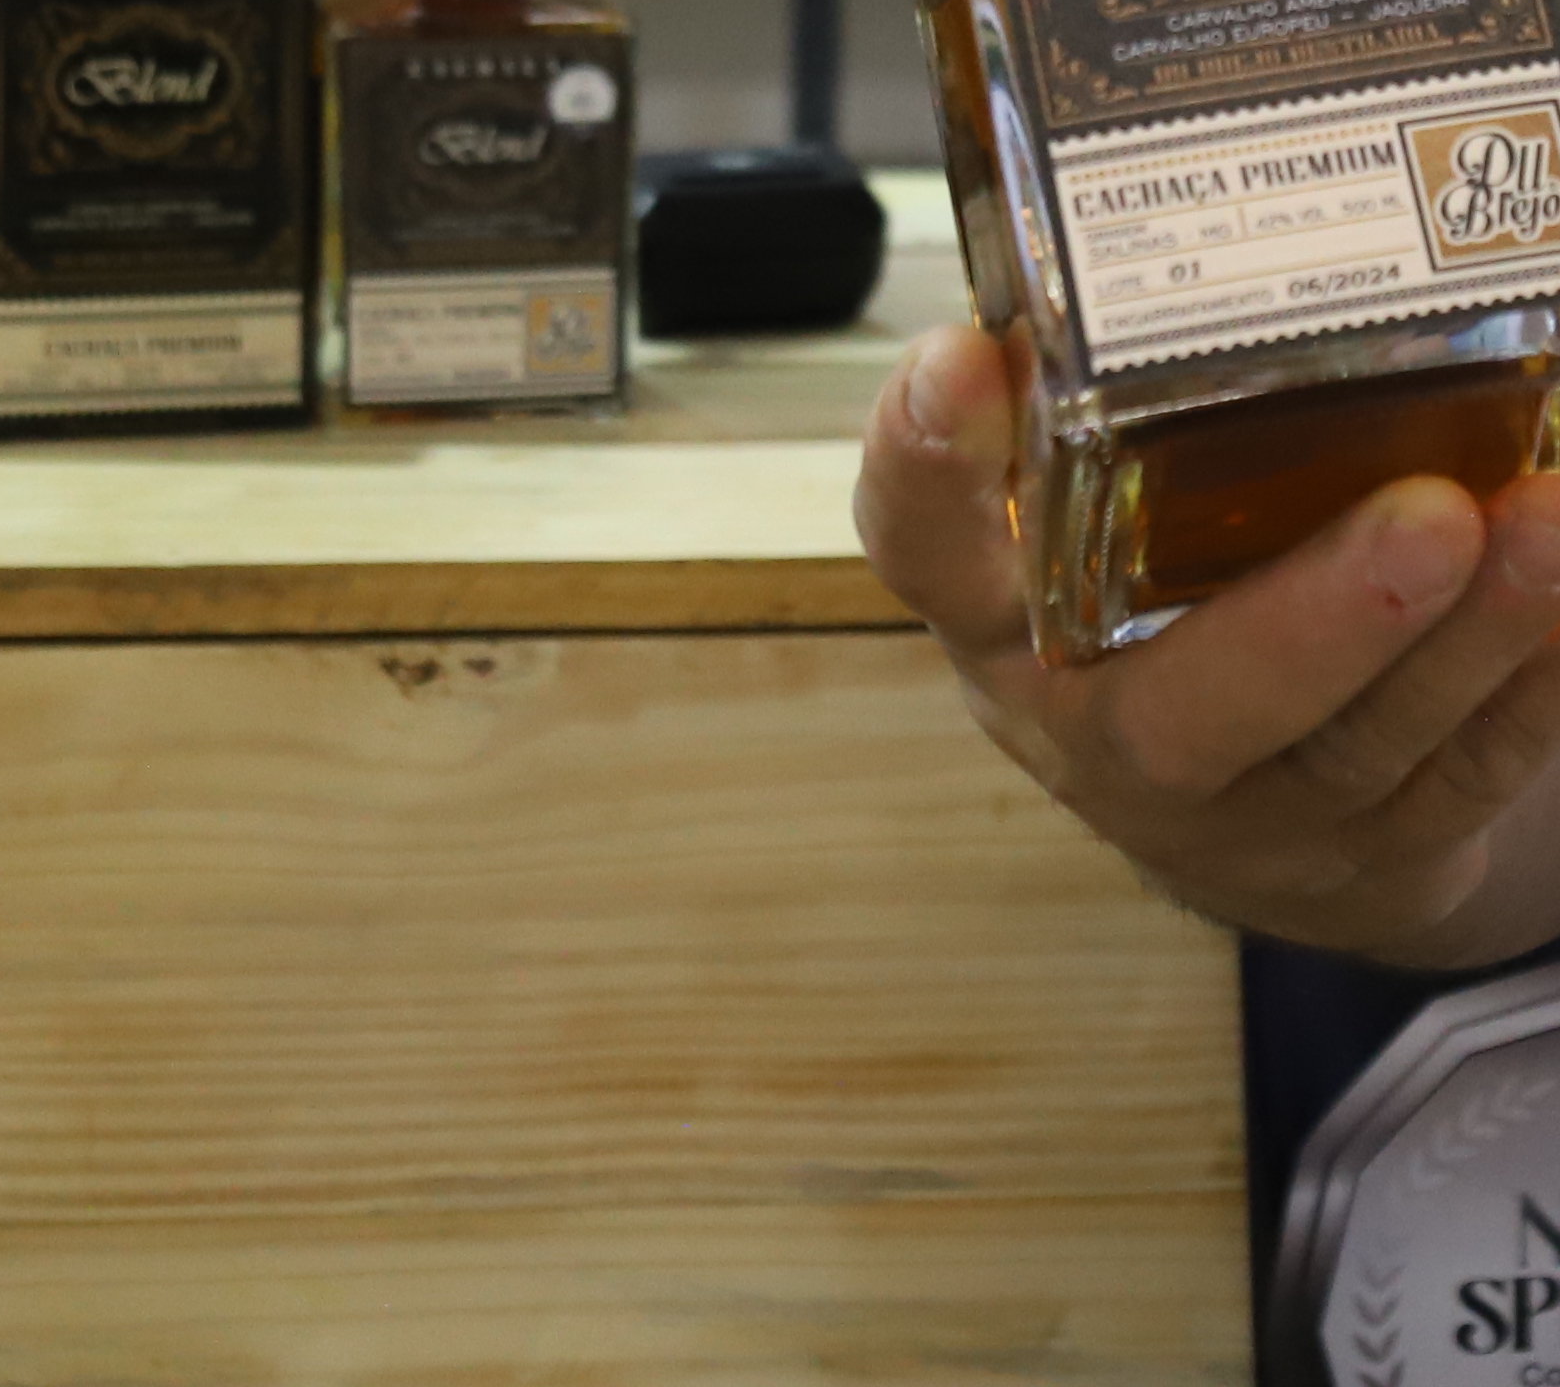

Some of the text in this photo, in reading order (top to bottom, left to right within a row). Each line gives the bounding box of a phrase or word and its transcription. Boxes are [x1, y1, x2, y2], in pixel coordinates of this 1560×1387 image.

[1165, 1, 1279, 33] CARVALHO
[1111, 28, 1227, 63] CARVALHO
[1231, 12, 1331, 44] EUROPEU
[1073, 139, 1399, 222] CACHAÇA PREMIUM
[1169, 260, 1201, 283] 01
[1287, 263, 1401, 300] 06/2024
